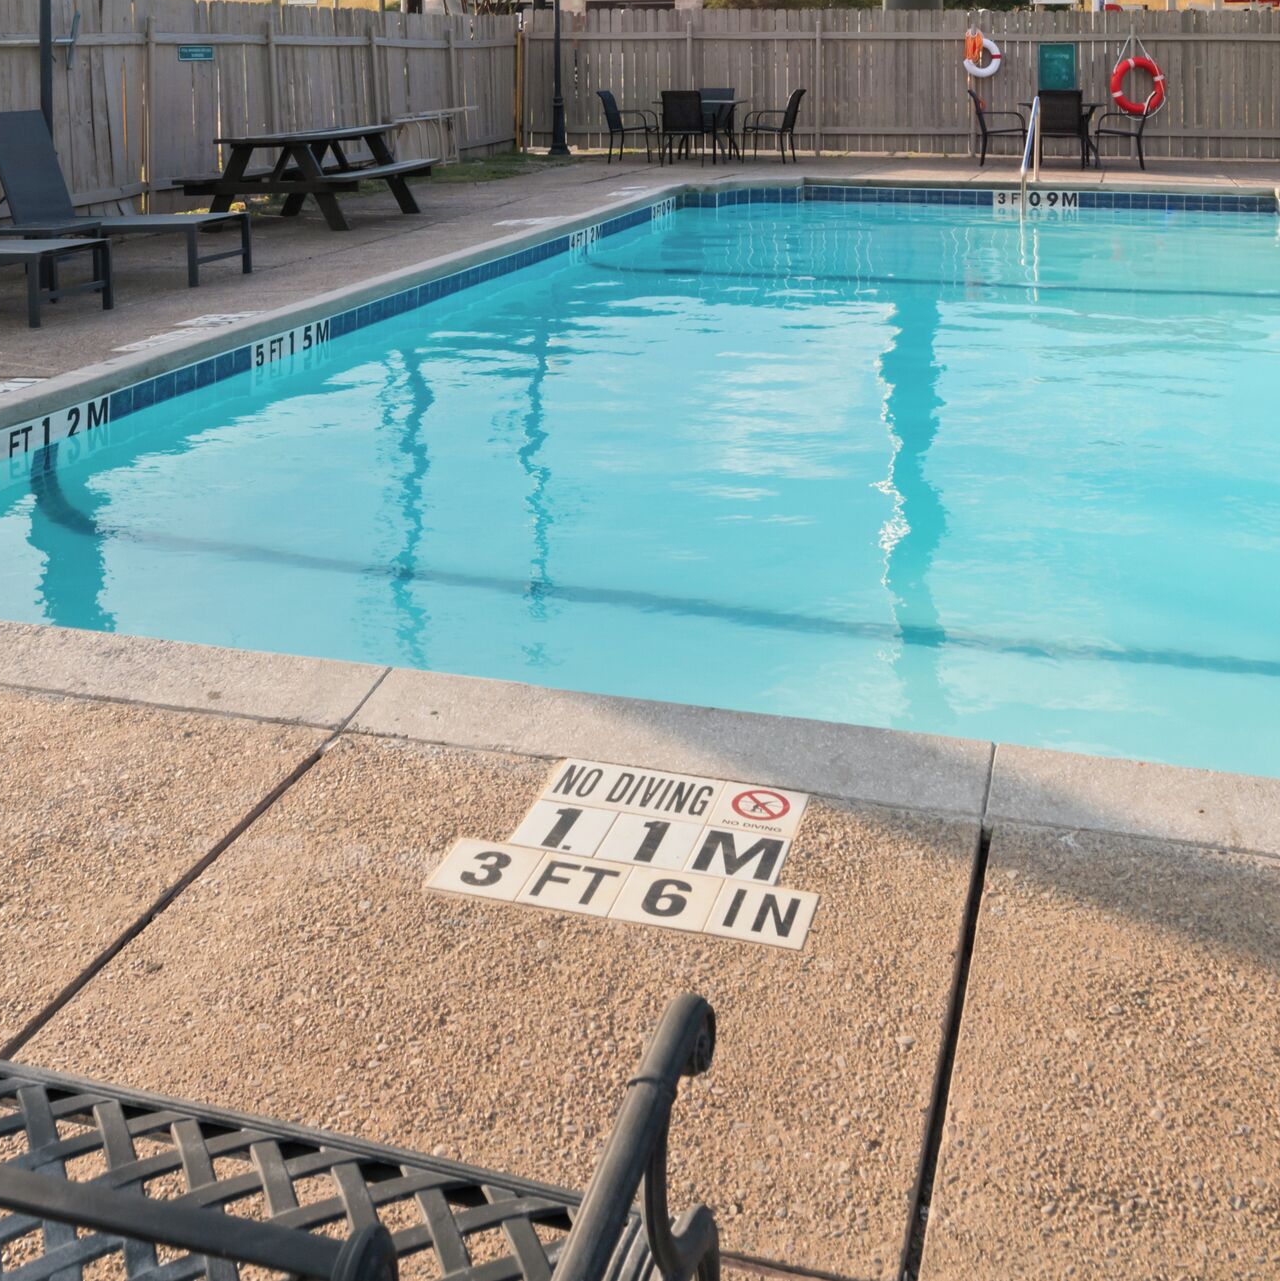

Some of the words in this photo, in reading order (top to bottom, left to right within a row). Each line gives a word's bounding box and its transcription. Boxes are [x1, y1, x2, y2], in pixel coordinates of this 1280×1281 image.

[256, 343, 264, 367] 5
[270, 337, 283, 362] FT
[9, 426, 33, 459] FT
[552, 764, 604, 798] NO
[605, 772, 714, 816] DIVING
[742, 822, 782, 832] DIVING
[460, 850, 512, 887] 3
[529, 860, 620, 905] FT
[641, 877, 693, 917] 6
[722, 888, 801, 938] IN
